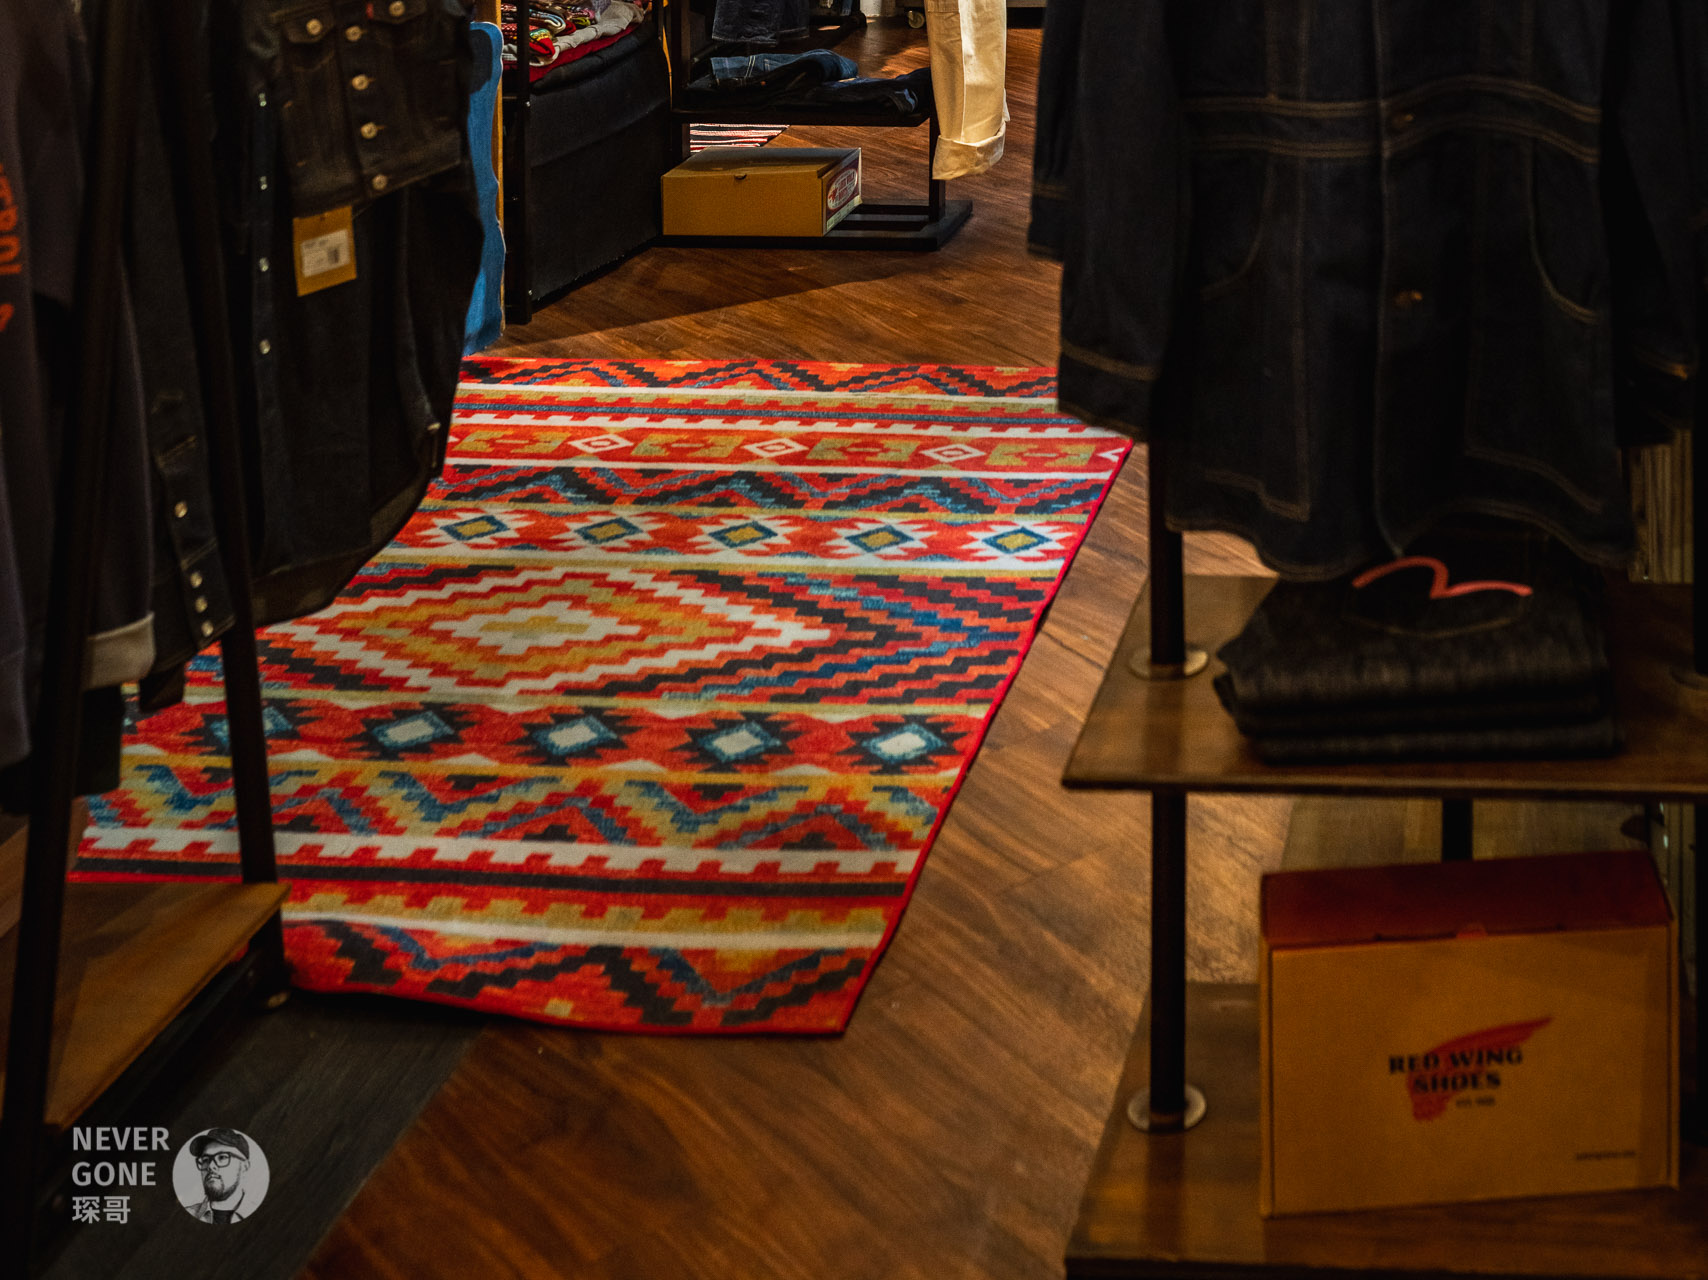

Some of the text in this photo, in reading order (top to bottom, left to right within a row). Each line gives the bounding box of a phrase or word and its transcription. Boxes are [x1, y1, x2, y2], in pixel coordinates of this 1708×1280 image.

[1388, 1046, 1524, 1074] RED WING
[1413, 1071, 1502, 1094] SHOES
